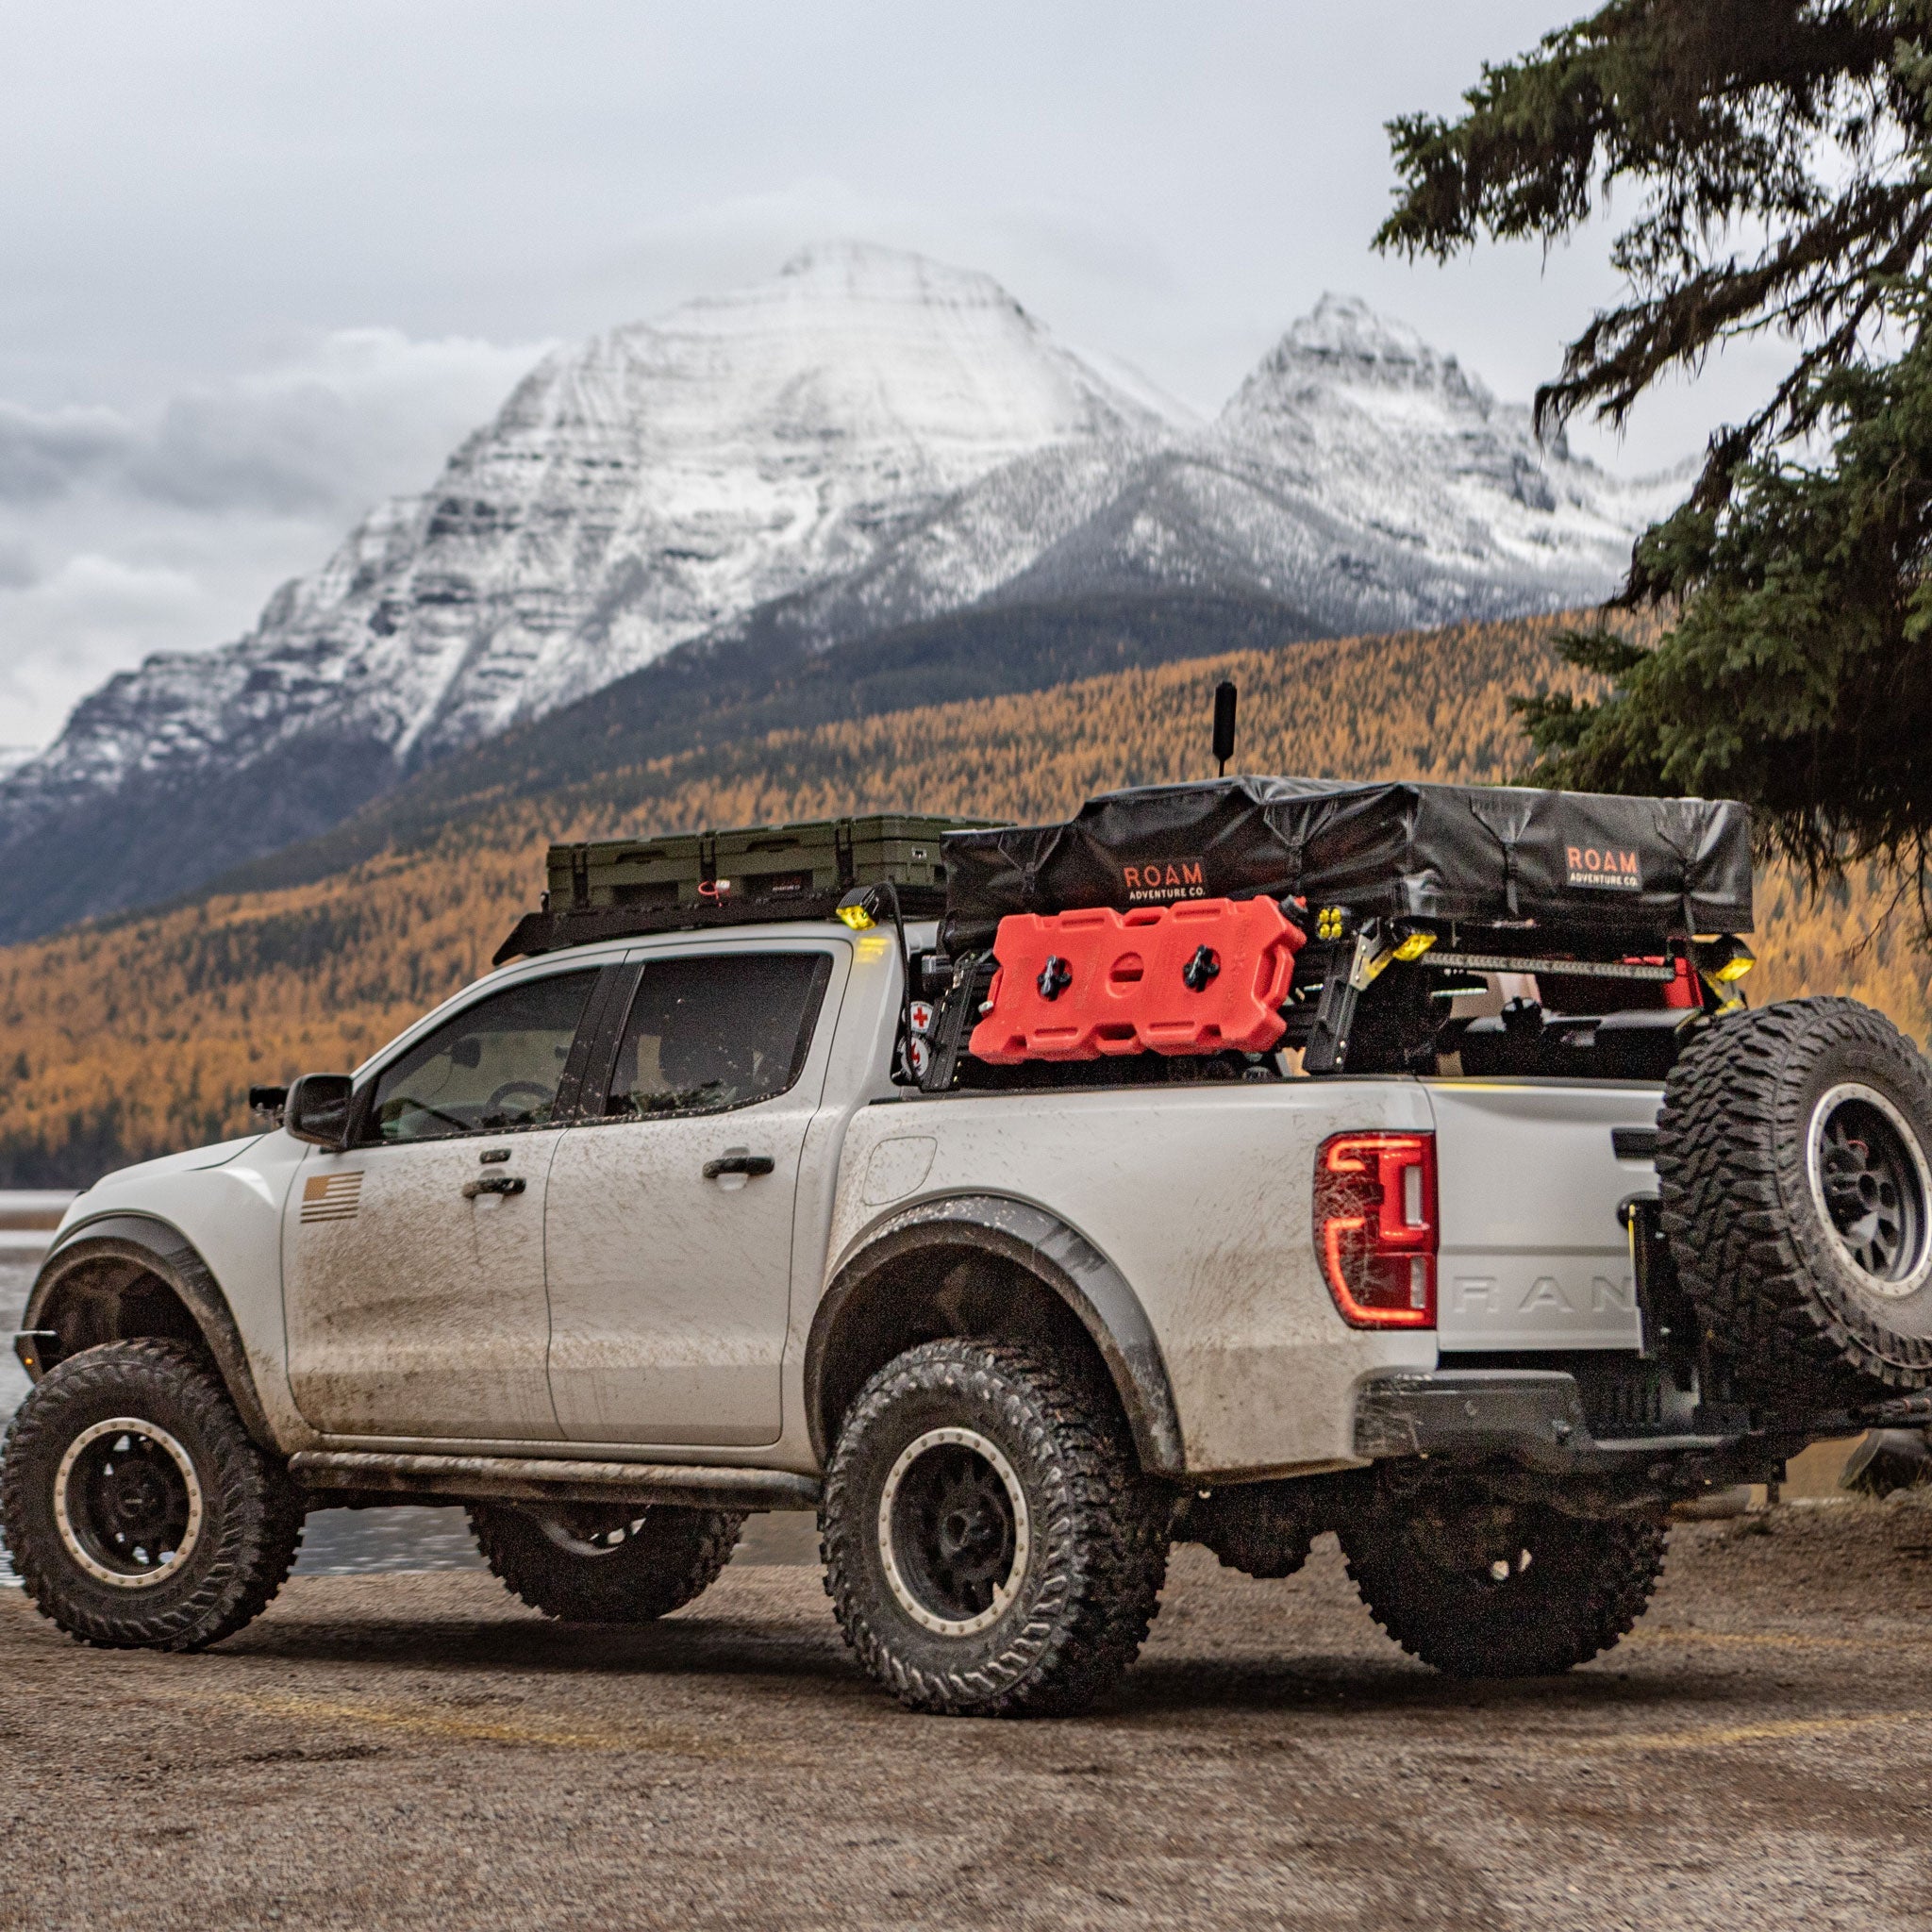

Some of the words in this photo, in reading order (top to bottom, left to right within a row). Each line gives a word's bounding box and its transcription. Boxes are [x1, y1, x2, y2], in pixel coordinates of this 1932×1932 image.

[1567, 846, 1639, 874] ROAM
[1124, 862, 1203, 888] ROAM
[1570, 872, 1623, 886] ADVENTURE
[1129, 888, 1187, 900] ADVENTURE
